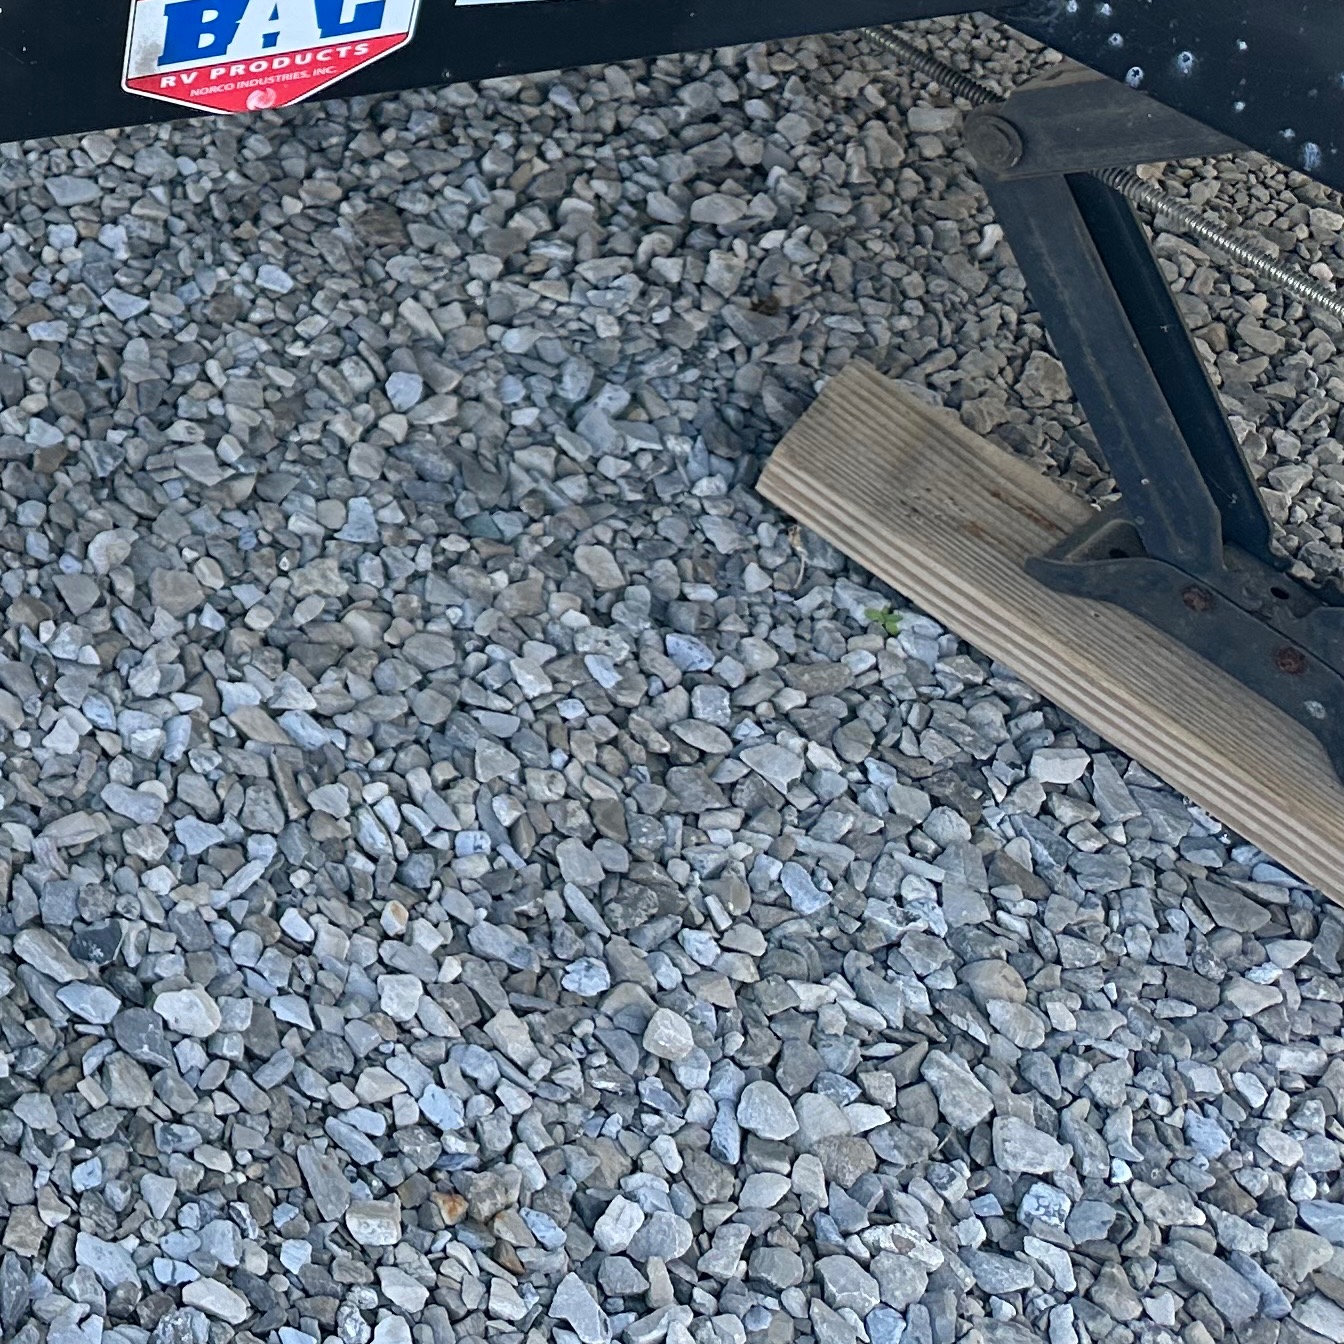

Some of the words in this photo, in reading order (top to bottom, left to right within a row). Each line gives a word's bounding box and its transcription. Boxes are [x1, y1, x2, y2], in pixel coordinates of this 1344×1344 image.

[160, 71, 199, 89] RV
[209, 43, 371, 80] PRODUCTS
[190, 82, 235, 97] NORCO
[236, 70, 311, 89] INDUSTRIES,
[312, 65, 338, 77] INC.
